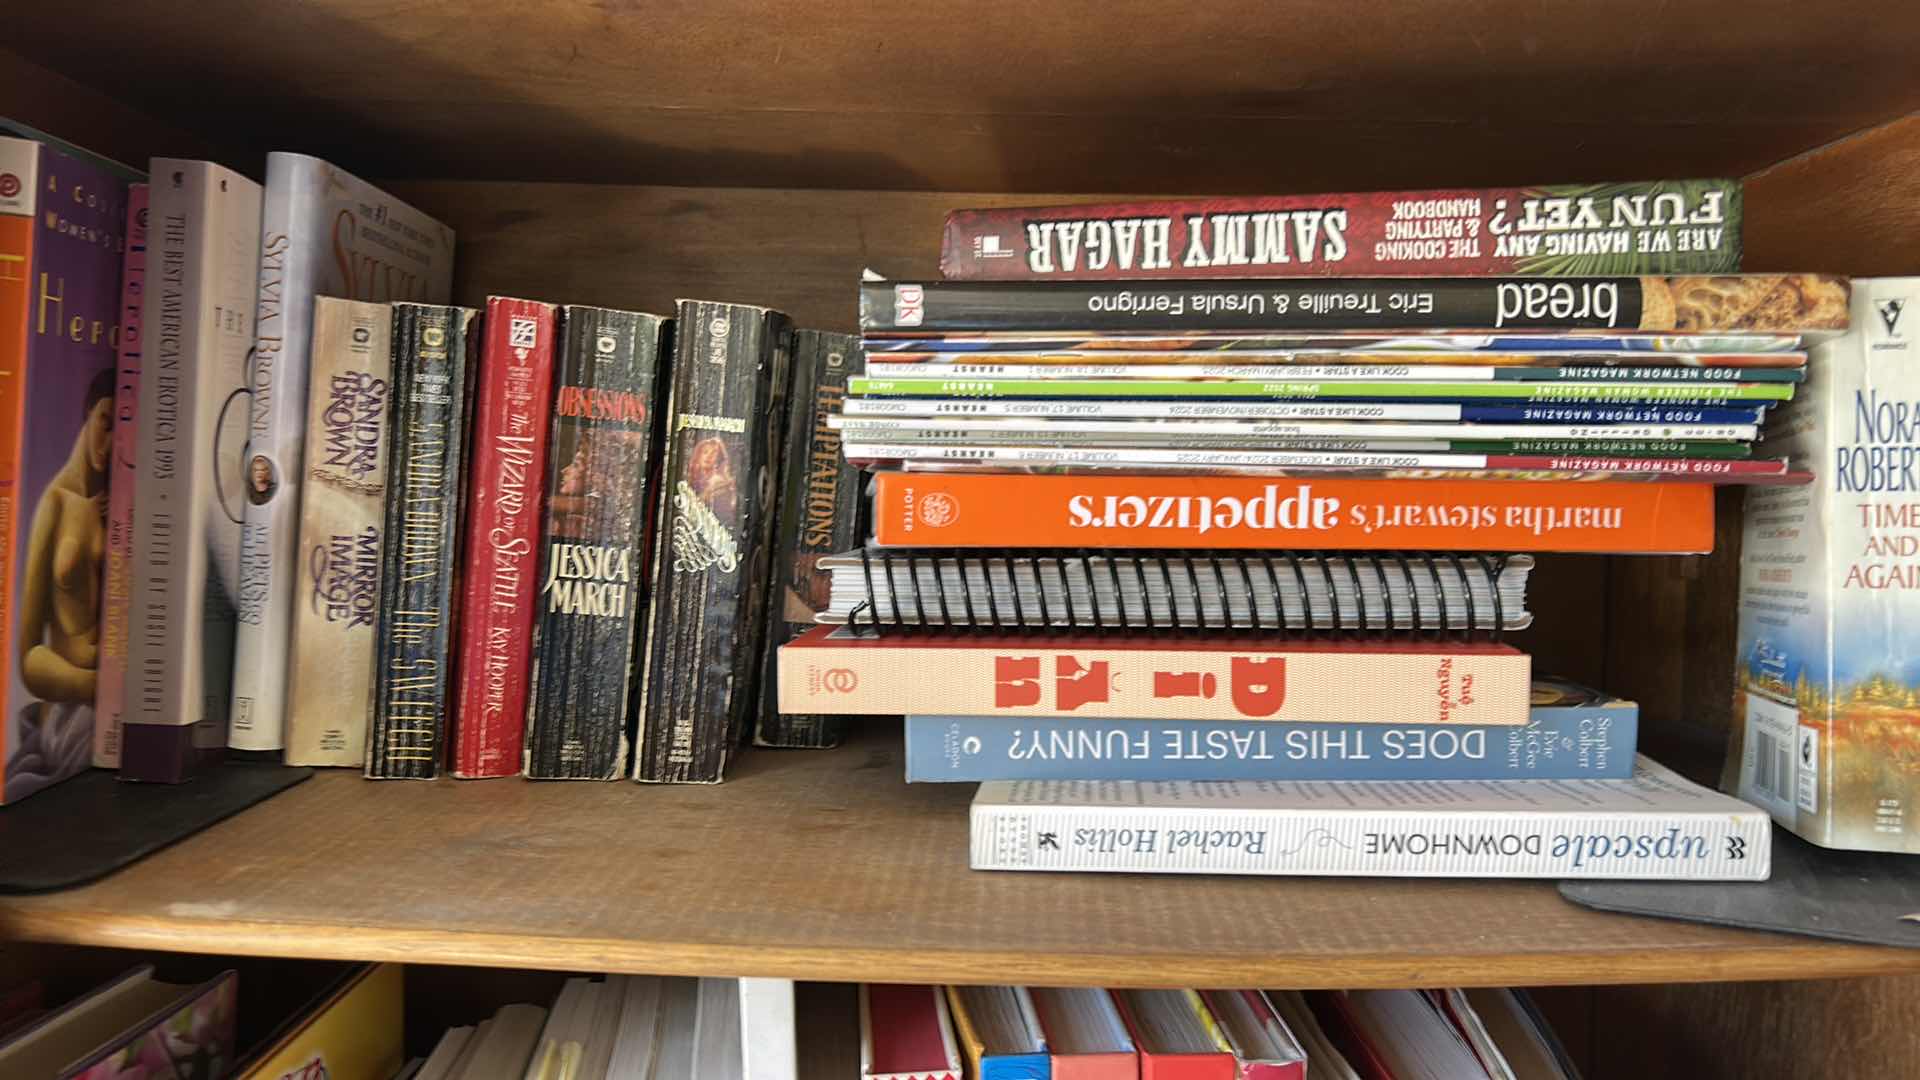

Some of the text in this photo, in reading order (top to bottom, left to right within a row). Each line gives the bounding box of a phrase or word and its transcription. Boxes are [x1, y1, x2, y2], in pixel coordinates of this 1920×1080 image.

[1393, 197, 1480, 220] HANDBOOK
[1609, 191, 1724, 228] FUN
[164, 214, 187, 242] THE
[1385, 218, 1480, 239] & PARTYING
[1026, 209, 1347, 273] SAMMY HAGAR
[1375, 237, 1480, 260] THE COOKING
[1494, 228, 1722, 258] ARE WE HAVING ANY
[162, 251, 186, 286] BEST
[899, 287, 920, 320] DK
[1088, 290, 1433, 315] Eric Treuille & Ursula Ferrigno
[1495, 282, 1618, 328] bread
[158, 291, 184, 370] AMERICAN
[252, 232, 290, 440] SYLVIA BROWNE
[952, 364, 1004, 373] HEARST
[1351, 367, 1358, 376] A
[1360, 367, 1380, 376] LIKE
[1382, 367, 1409, 376] COOK
[1558, 367, 1628, 378] MAGAZINE
[1633, 368, 1699, 378] NETWORK
[1704, 369, 1741, 379] FOOD
[942, 382, 993, 391] HEARST
[1535, 385, 1599, 396] MAGAZINE
[1605, 386, 1649, 396] WOMAN
[1720, 387, 1743, 397] THE
[153, 376, 180, 442] EROTICA
[558, 385, 646, 424] OBSESSIONS
[936, 404, 986, 412] HEARST
[1327, 407, 1334, 416] A
[1336, 407, 1356, 417] LIKE
[1358, 407, 1384, 417] COOK
[1523, 409, 1591, 420] MAGAZINE
[1597, 410, 1660, 421] NETWORK
[1665, 411, 1701, 422] FOOD
[322, 371, 361, 467] BROWN
[351, 373, 389, 478] SANDRA
[918, 430, 967, 438] HEARST
[1512, 441, 1579, 450] MAGAZINE
[1585, 441, 1645, 451] NETWORK
[1651, 442, 1686, 451] FOOD
[943, 450, 994, 458] HEARST
[1371, 456, 1390, 466] LIKE
[1393, 457, 1419, 467] COOK
[1549, 459, 1622, 470] MAGAZINE
[1625, 460, 1688, 472] NETWORK
[494, 435, 536, 515] WIZARD
[1693, 462, 1731, 473] FOOD
[903, 488, 914, 532] POTTER
[1068, 483, 1622, 536] martha stewart's appetizers
[1863, 535, 1919, 560] AND
[253, 552, 272, 603] PETS
[320, 535, 353, 623] IMAGE
[347, 526, 379, 630] MIRROR
[488, 528, 532, 615] SEATTLE
[542, 543, 632, 593] JESSICA
[1842, 564, 1920, 589] AGAI
[550, 579, 627, 618] MARCH
[491, 627, 512, 652] KAY
[485, 654, 510, 715] HOOPER
[1007, 729, 1487, 760] DOES THIS TASTE FUNNY?
[1527, 720, 1542, 769] McGee
[1543, 731, 1559, 759] Evie
[1578, 719, 1595, 768] Colbert
[1594, 718, 1612, 769] Stephen
[1073, 827, 1711, 867] upscale DOWNHOME Rachel Hollis
